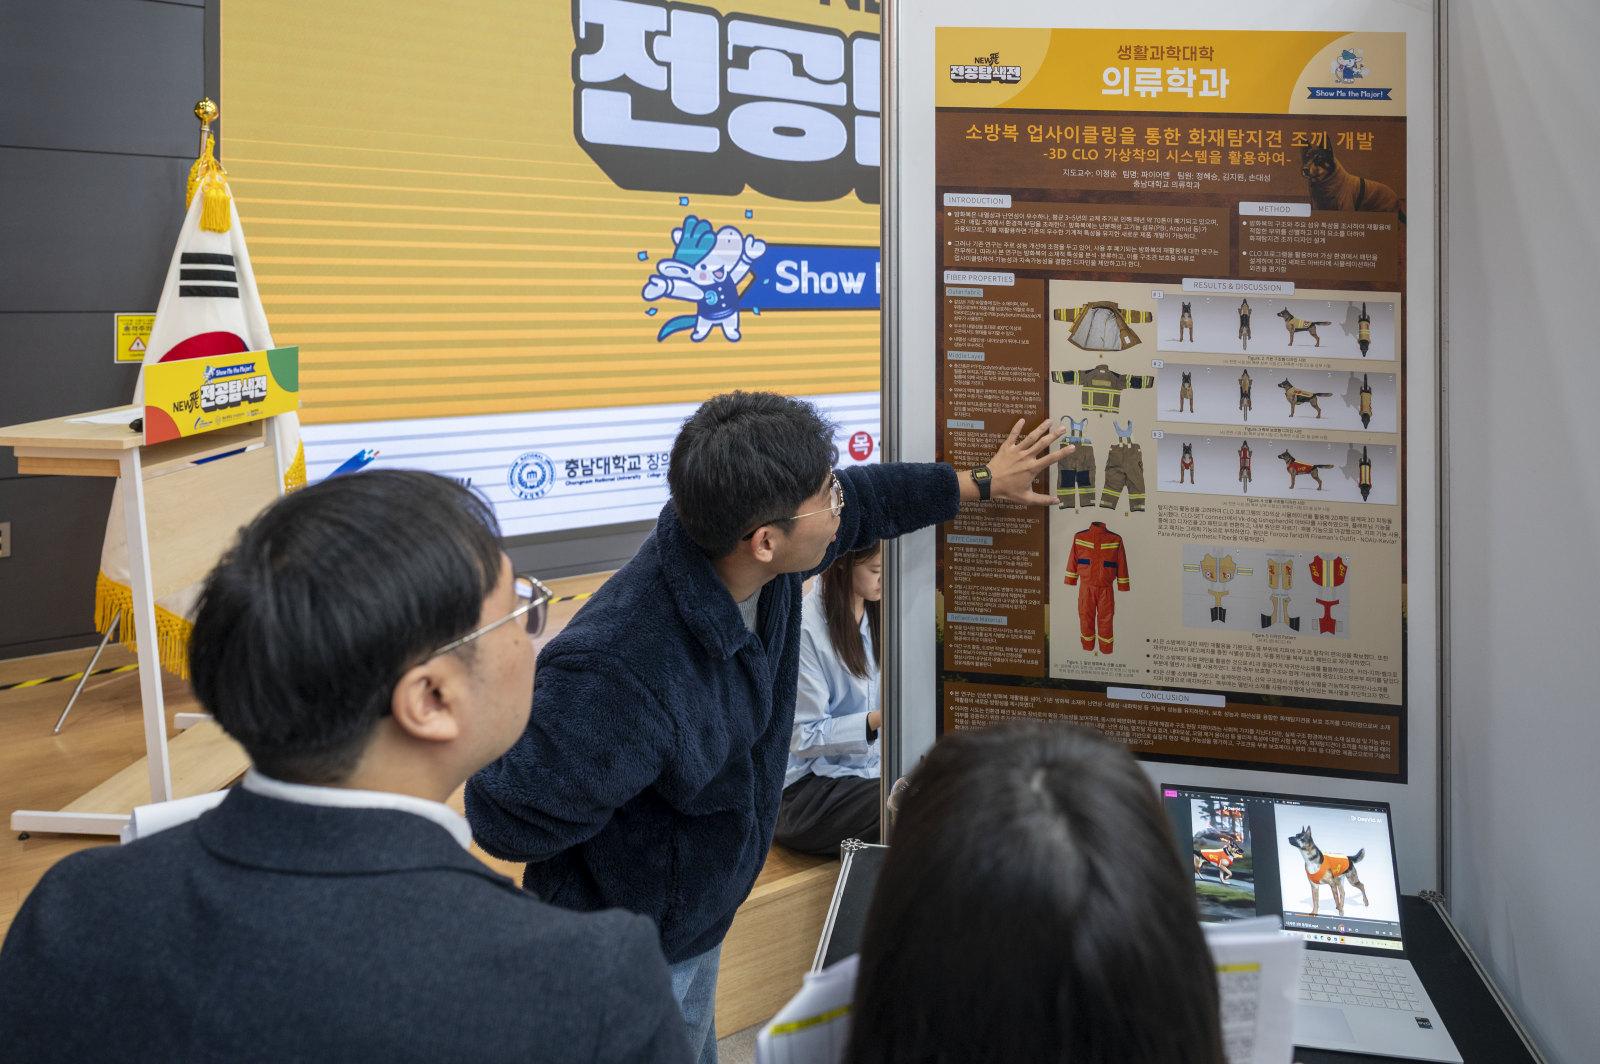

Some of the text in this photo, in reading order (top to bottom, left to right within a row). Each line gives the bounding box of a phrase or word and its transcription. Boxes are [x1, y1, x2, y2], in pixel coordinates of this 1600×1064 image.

[1116, 44, 1214, 62] 생활과학대학
[950, 65, 1021, 82] 전공탐색전
[1101, 67, 1230, 98] 의류학과
[1361, 90, 1383, 99] Major!
[965, 123, 1375, 150] 소방복 업사이클링을 통한 화재탐지견 조끼 개발
[1043, 149, 1291, 167] -3D CLO 가상착의 시스템을 활용하여-
[1063, 169, 1093, 178] 지도교수:
[1095, 169, 1117, 178] 이정순
[1122, 170, 1138, 179] 팀명:
[1141, 170, 1170, 180] 파이어맨
[1177, 171, 1193, 180] 팀원:
[1133, 180, 1200, 189] 충남대학교 의류학과
[949, 196, 1004, 205] INTRODUCTION
[775, 260, 865, 294] Show
[968, 275, 1013, 283] PROPERTIES
[1235, 283, 1282, 291] DISCUSSION
[216, 368, 226, 376] Show
[200, 375, 267, 409] 전공탐색전
[852, 434, 870, 455] 목
[565, 455, 641, 478] 충남대학교
[1141, 693, 1190, 702] CONCLUSION
